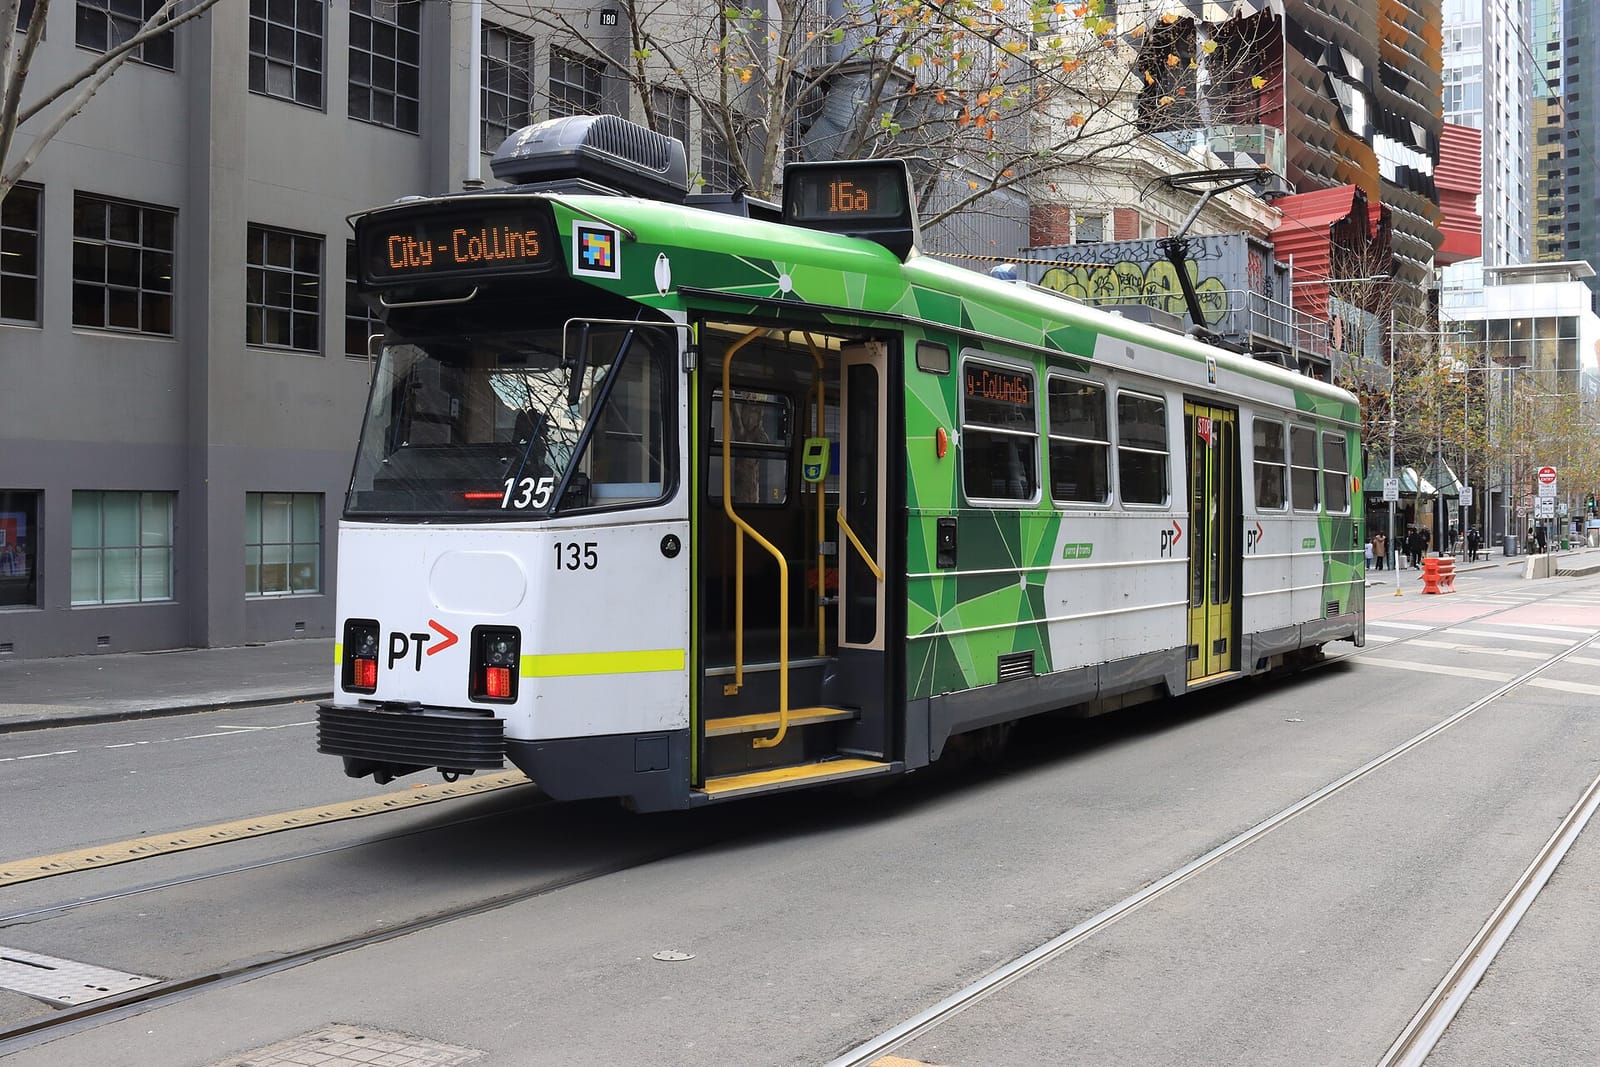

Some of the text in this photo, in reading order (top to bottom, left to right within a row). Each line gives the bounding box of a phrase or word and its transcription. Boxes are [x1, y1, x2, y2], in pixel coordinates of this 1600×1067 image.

[603, 14, 616, 25] 180
[829, 182, 868, 212] 16a
[388, 234, 432, 269] City
[453, 226, 540, 264] Collins
[501, 477, 554, 509] 135
[554, 542, 598, 571] 135
